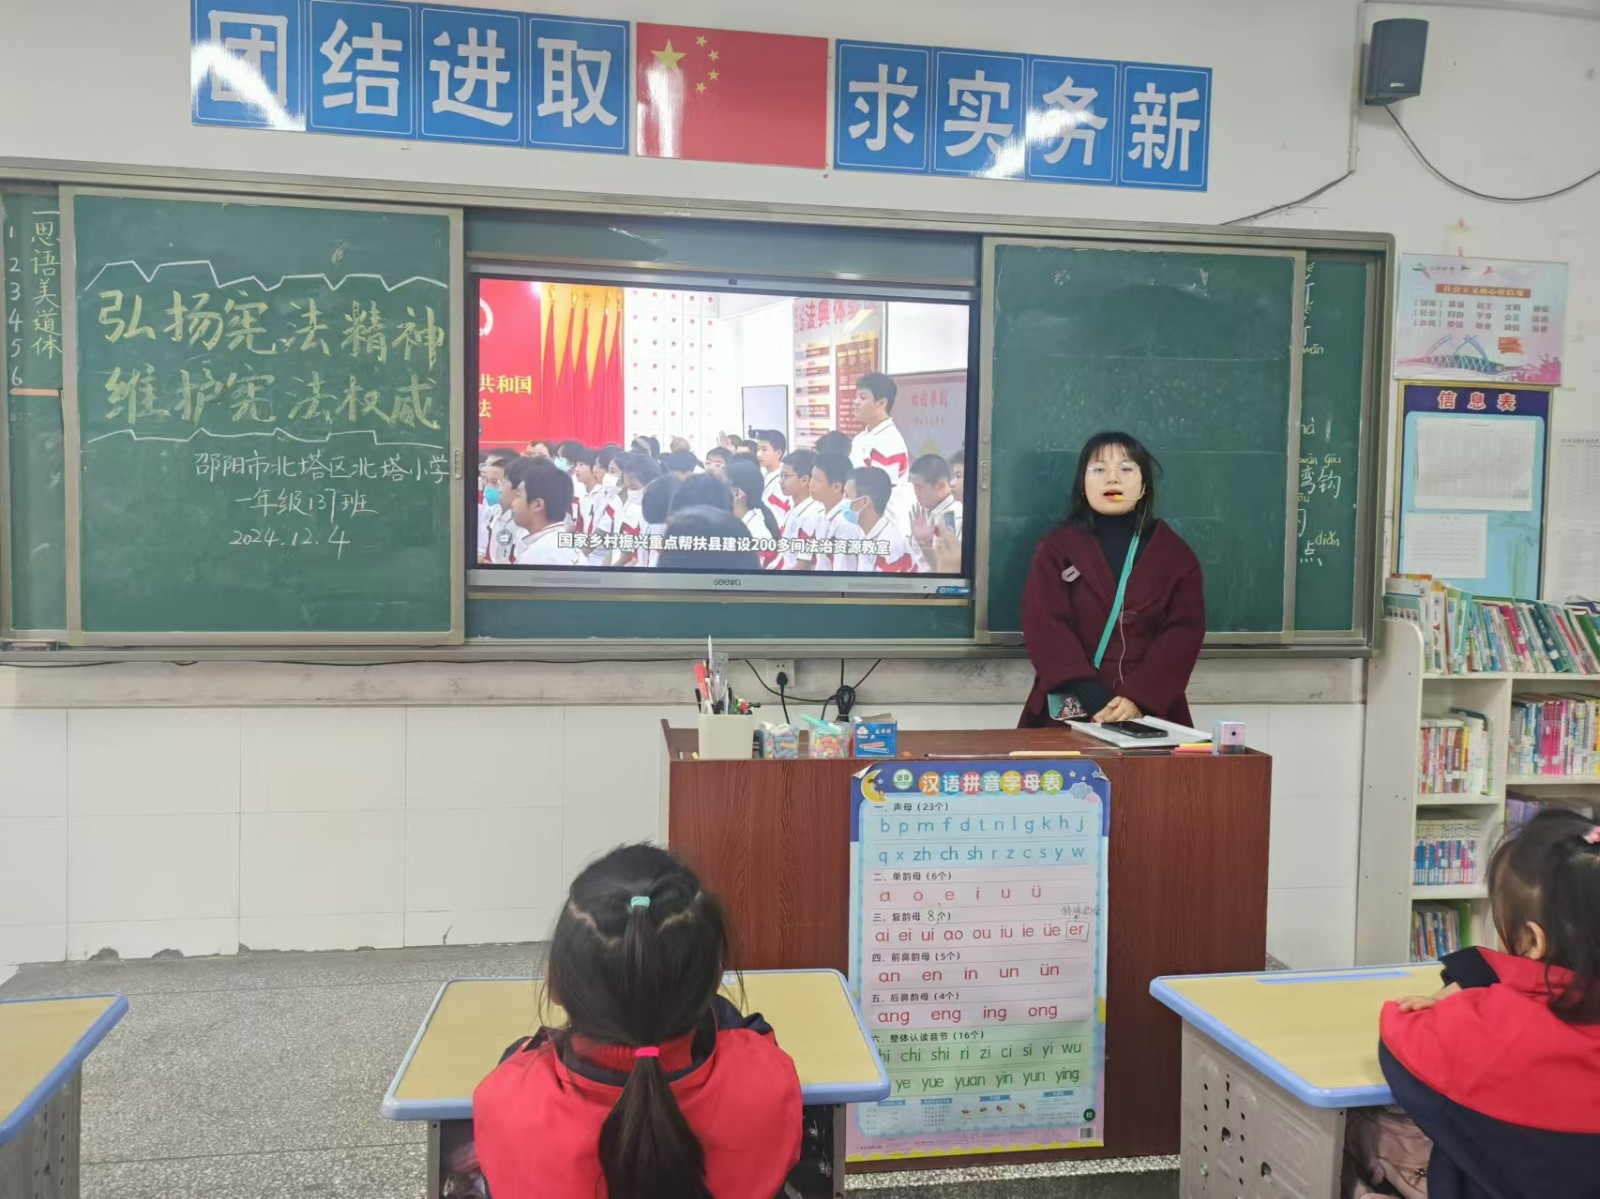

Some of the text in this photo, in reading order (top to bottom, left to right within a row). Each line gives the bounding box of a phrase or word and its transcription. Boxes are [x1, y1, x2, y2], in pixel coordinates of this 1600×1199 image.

[205, 12, 614, 128] 团结进取
[847, 62, 1200, 172] 求实务新
[9, 226, 14, 238] 1
[9, 257, 22, 272] 2
[9, 282, 21, 300] 3
[8, 308, 23, 333] 4
[99, 290, 446, 368] 弘扬宪法精神
[10, 338, 22, 358] 5
[11, 366, 23, 386] 6
[479, 374, 532, 395] 共和国
[104, 364, 440, 429] 维护宪法权威
[1437, 391, 1516, 410] 信息表
[195, 449, 449, 485] 邵阳市北塔区北塔小学
[1300, 466, 1342, 499] 弯钩
[234, 489, 378, 522] 一年级137班
[229, 526, 351, 560] 2024.12.4
[557, 532, 890, 556] 国家乡村振兴重点帮扶县建设200多间法治资源教室
[1300, 540, 1322, 566] 点
[922, 773, 1062, 793] 汉语拼音字母表
[880, 815, 1084, 836] b p m f d t n l g k h j
[879, 846, 1085, 864] q x zh ch sh r z c s y w
[879, 884, 1041, 901] a o e i u ü
[875, 922, 1084, 942] ai ei ui ao ou iu ie üe er
[879, 964, 1059, 982] an en in un ün
[878, 1005, 1057, 1026] ang eng ing ong
[879, 1042, 1082, 1063] hi chi shi ri zi ci si yi wu
[896, 1067, 1079, 1092] ye yue yuan yin yun ying
